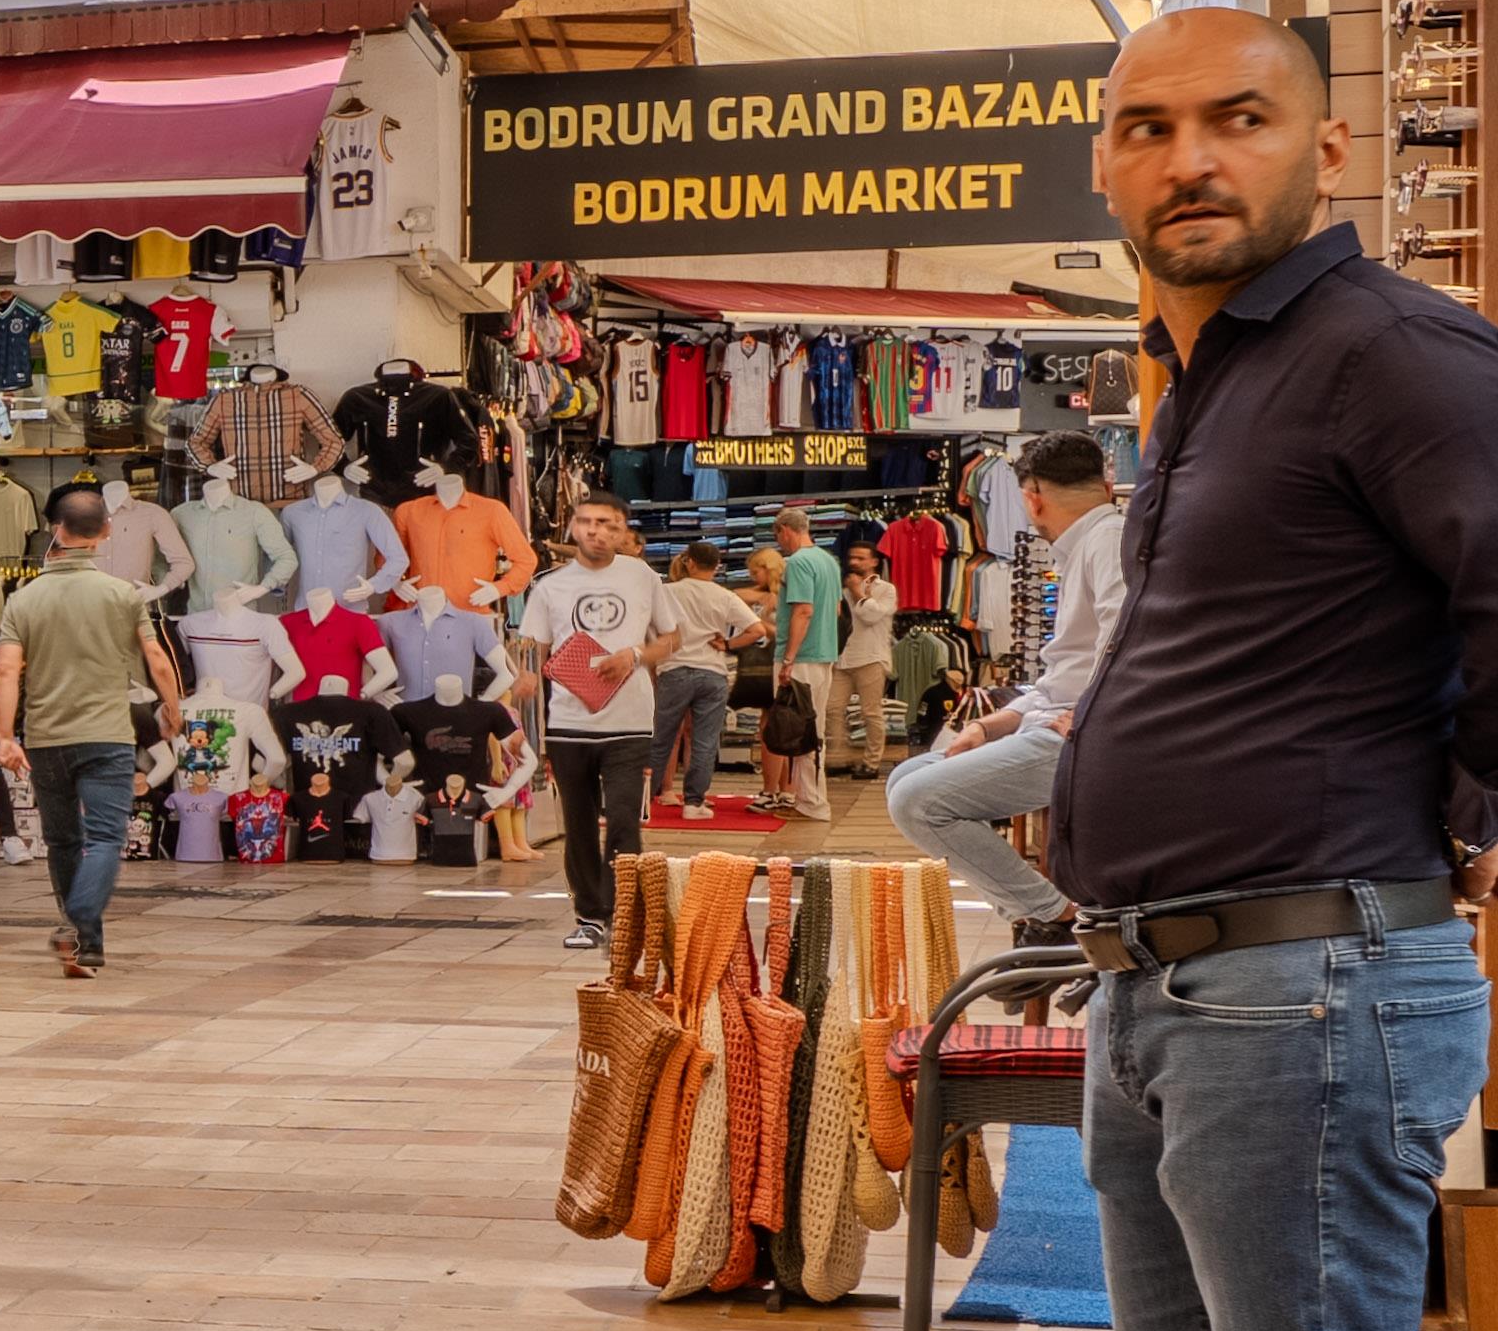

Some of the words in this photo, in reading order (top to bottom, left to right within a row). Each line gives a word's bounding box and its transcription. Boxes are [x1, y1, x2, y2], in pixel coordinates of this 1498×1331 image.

[482, 98, 694, 153] BODRUM
[706, 89, 887, 144] GRAND
[332, 169, 374, 209] 23
[573, 172, 787, 226] BODRUM
[802, 162, 1024, 217] MARKET
[62, 332, 75, 358] 8
[170, 333, 190, 373] 7
[628, 370, 649, 403] 15
[996, 367, 1014, 392] 10
[696, 450, 714, 465] 4XL
[804, 435, 847, 466] SHOP
[847, 436, 867, 449] 5XL
[846, 452, 867, 466] 6XL
